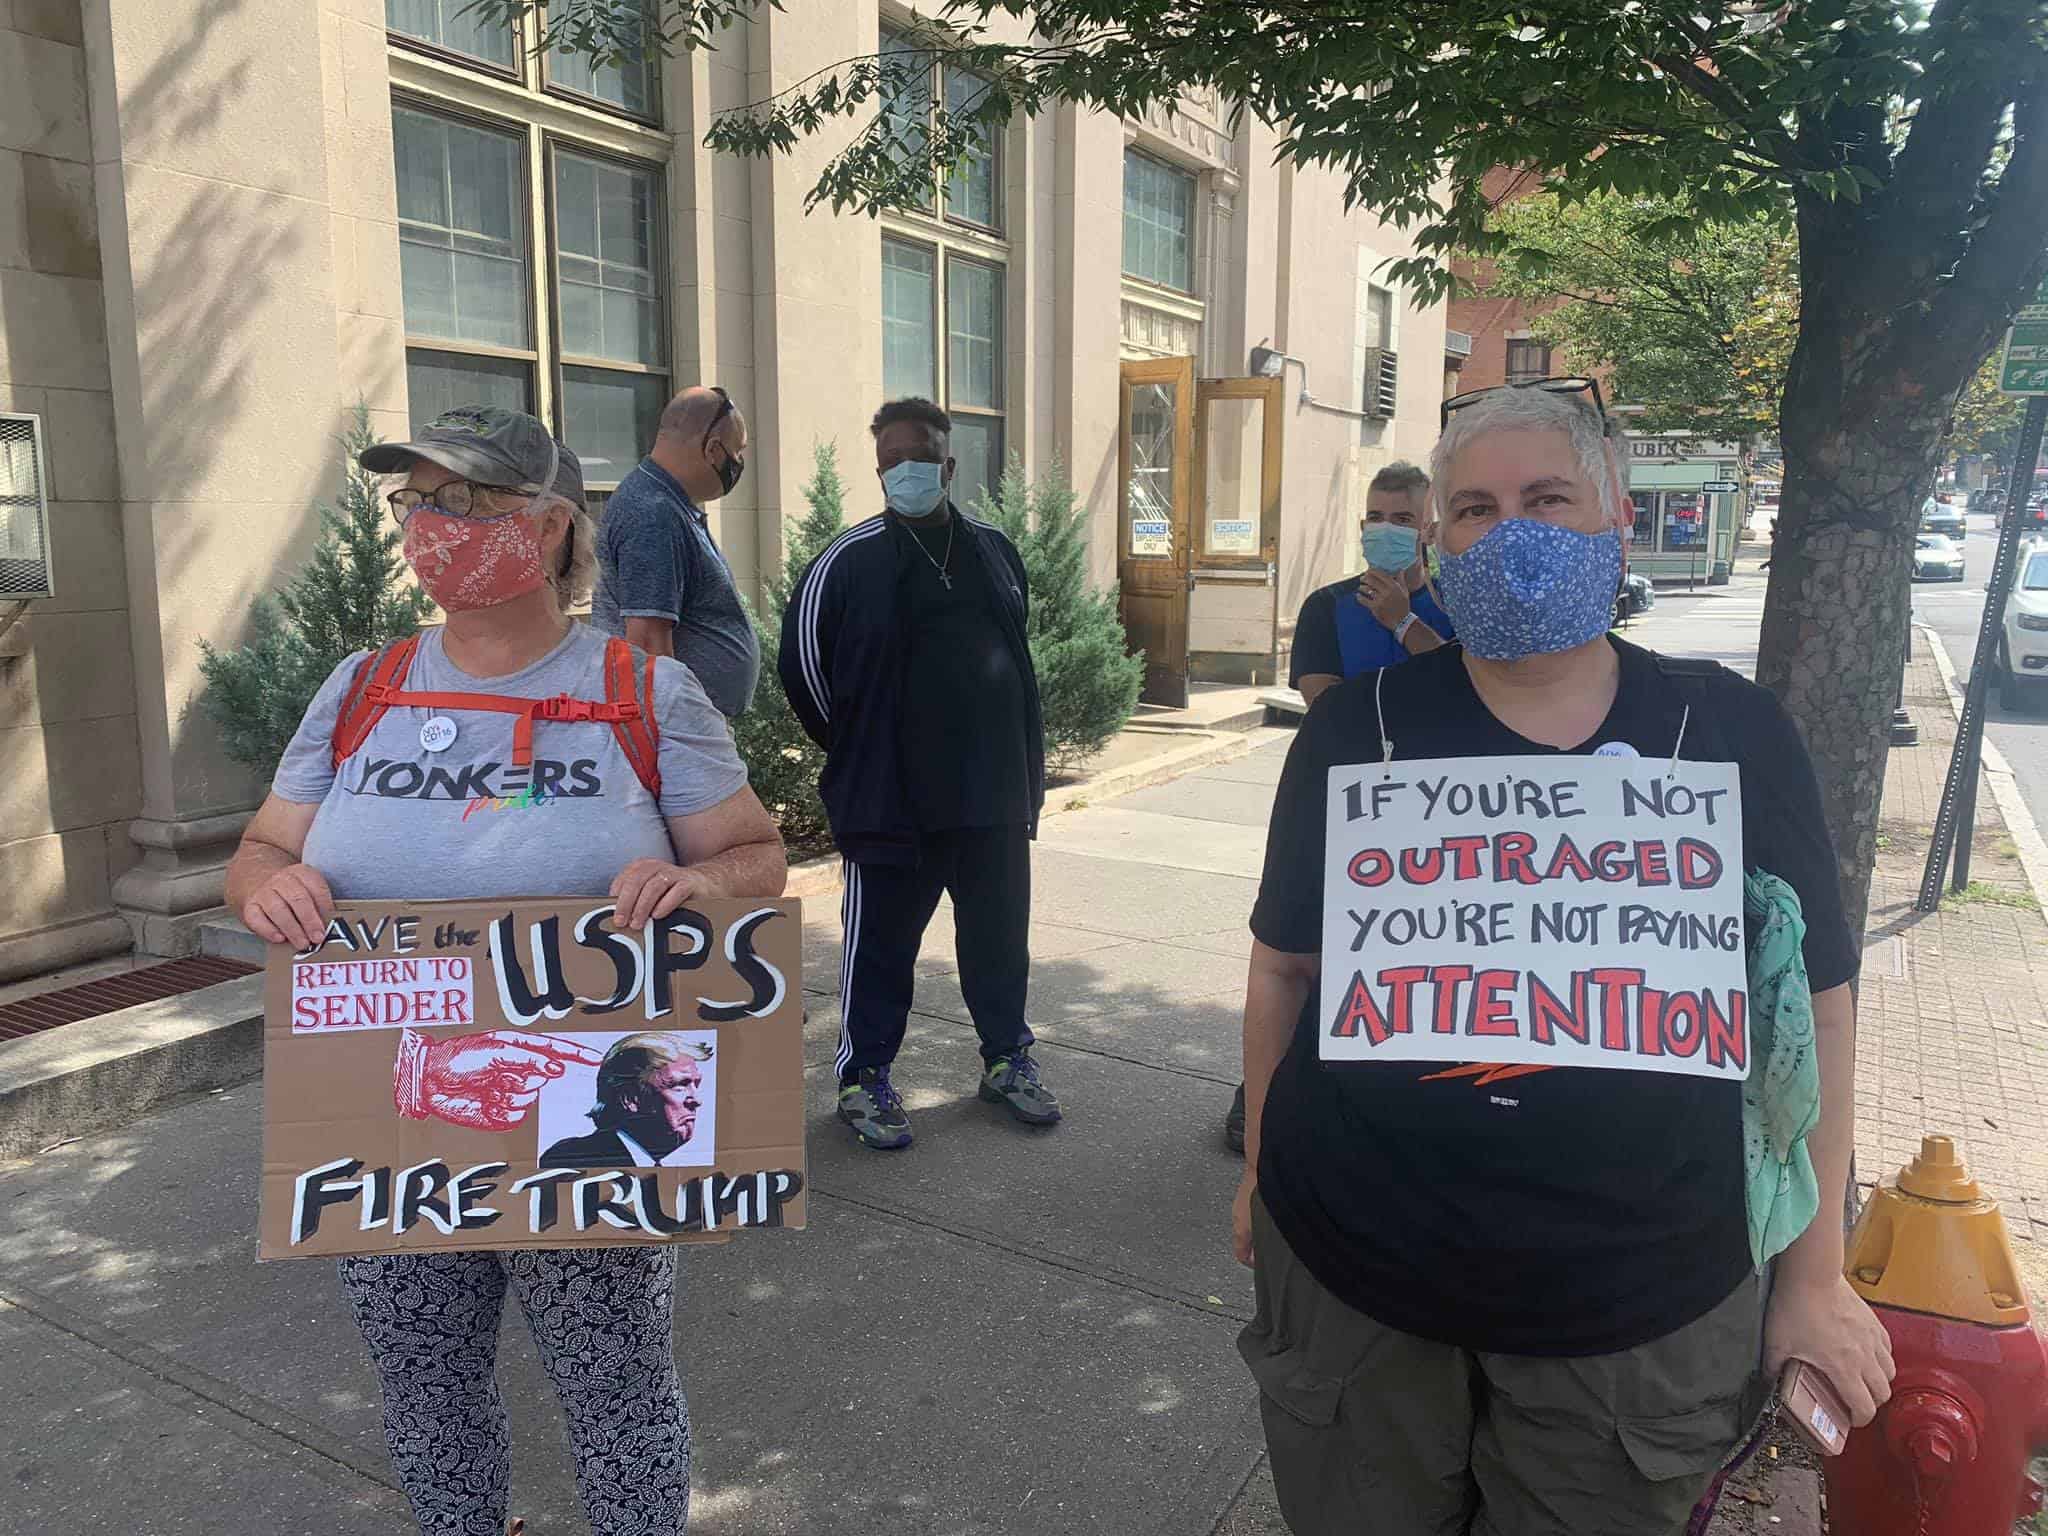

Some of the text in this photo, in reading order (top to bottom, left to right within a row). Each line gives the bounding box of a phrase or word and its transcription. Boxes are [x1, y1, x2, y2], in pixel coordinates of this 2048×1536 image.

[1135, 523, 1166, 534] NOTICE
[356, 757, 601, 800] YONKERS
[1342, 775, 1728, 825] IF YOU'RE NOT
[1347, 831, 1723, 889] OUTRAGED
[1347, 900, 1740, 952] YOU'RE NOT PAYING
[296, 958, 467, 989] RETURN TO
[434, 920, 480, 949] the
[487, 904, 787, 1026] USPS
[294, 988, 472, 1031] SENDER
[1330, 964, 1747, 1071] ATTENTION
[290, 1157, 804, 1246] FIRE TRUMP
